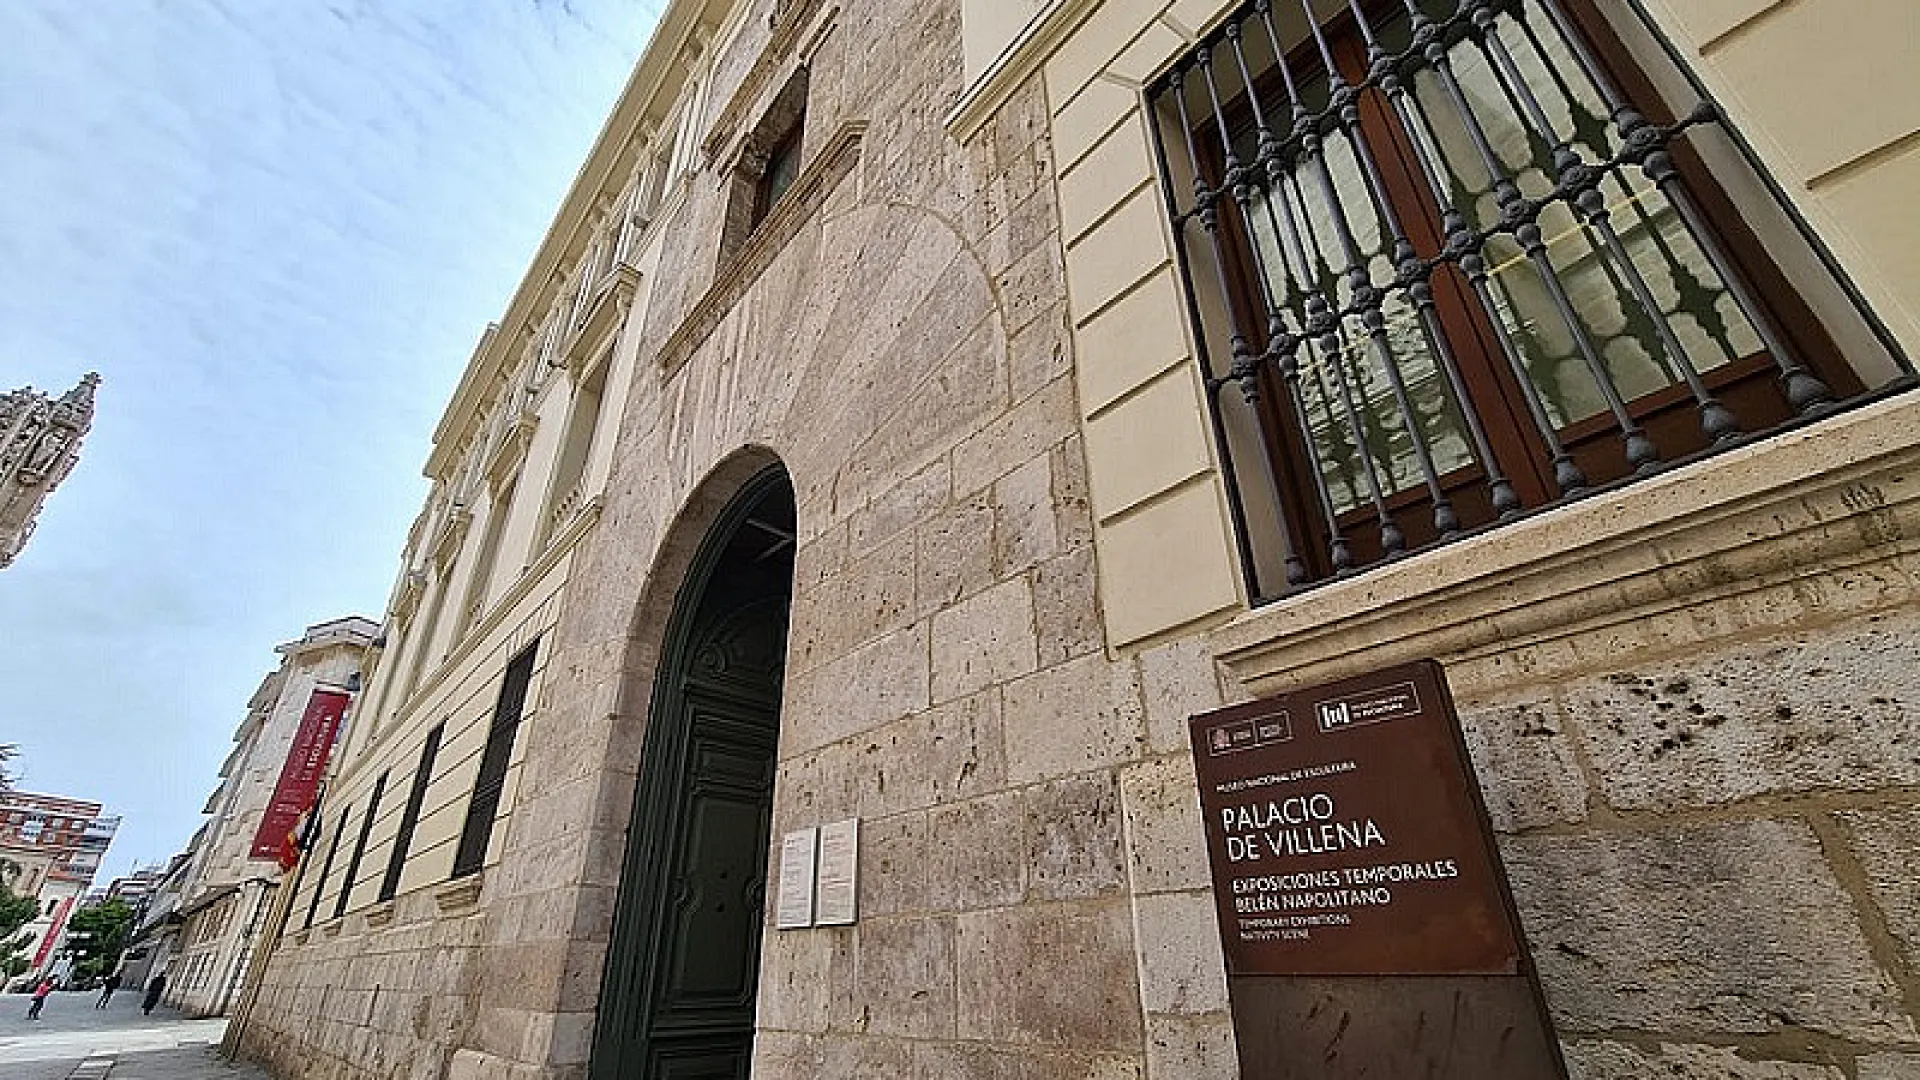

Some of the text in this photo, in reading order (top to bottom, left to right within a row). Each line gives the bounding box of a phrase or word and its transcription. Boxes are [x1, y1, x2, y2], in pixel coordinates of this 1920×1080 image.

[1223, 794, 1332, 832] PALACIO
[1228, 818, 1385, 861] DE VILLENA
[1233, 860, 1457, 893] EXPOSICIONES TEMPORALES
[1236, 888, 1390, 912] BELÉN NAPOLITANO
